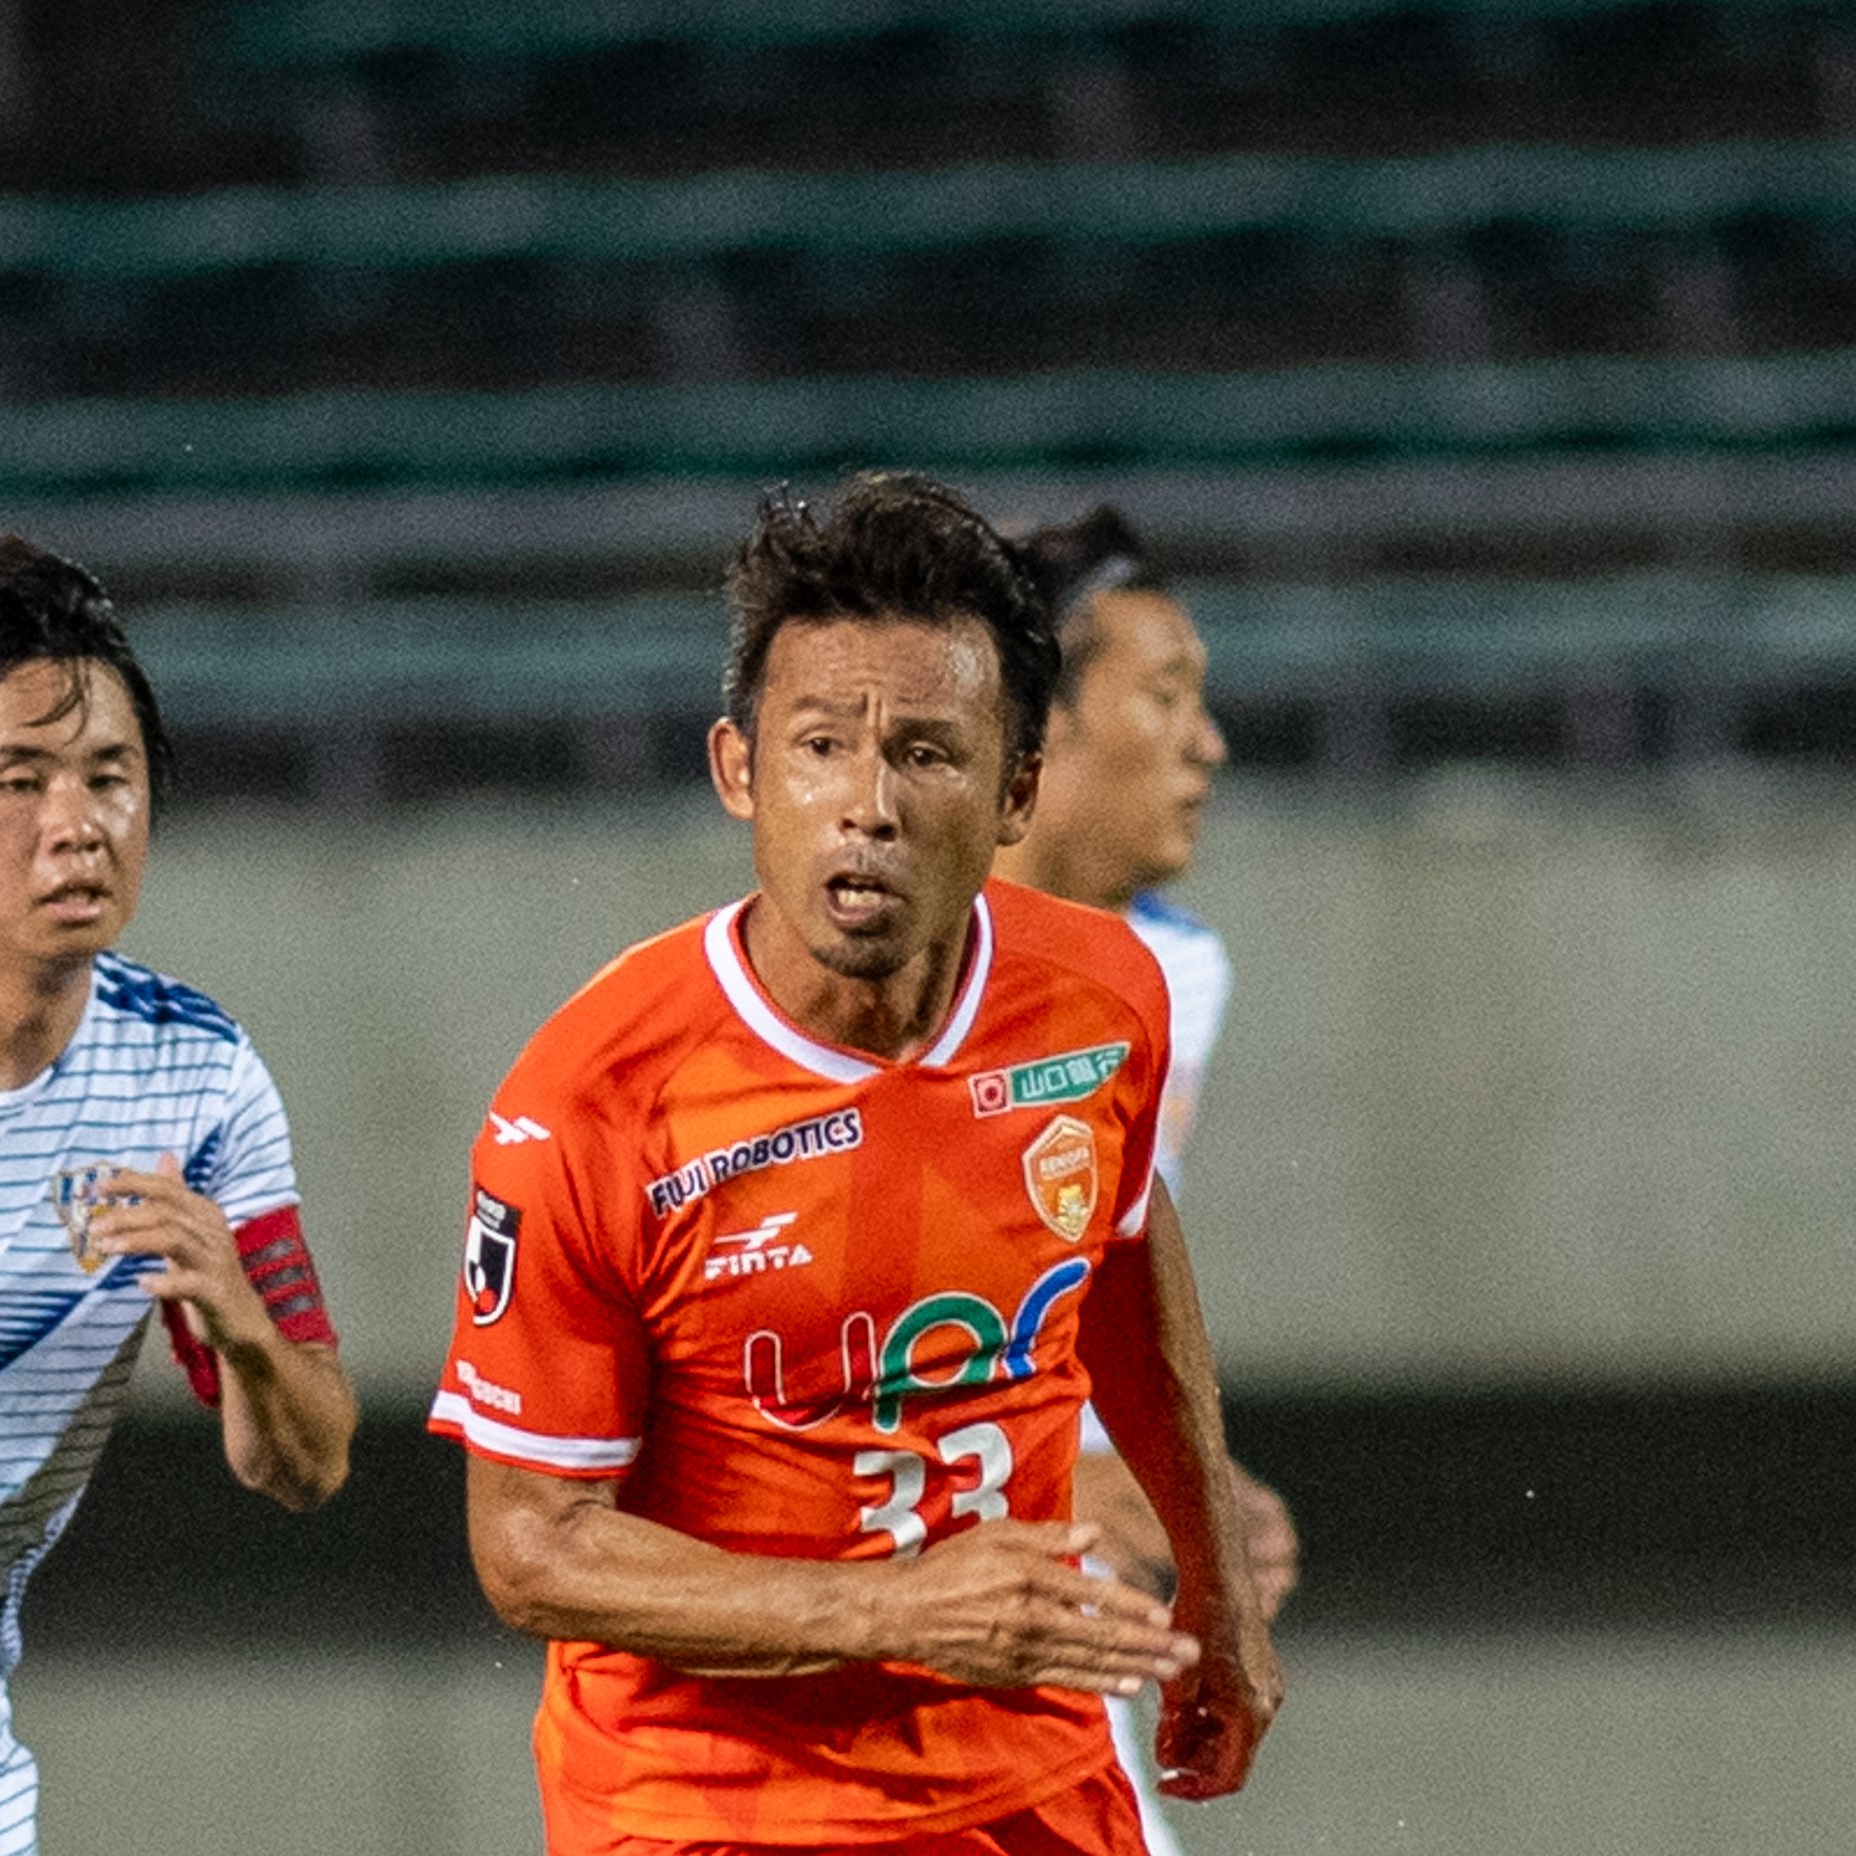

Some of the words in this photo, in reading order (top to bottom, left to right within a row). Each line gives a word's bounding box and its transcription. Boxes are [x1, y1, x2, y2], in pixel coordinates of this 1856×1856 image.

[710, 1112, 859, 1182] ROBOTICS
[745, 1257, 1090, 1433] upr
[853, 1422, 1013, 1558] 33
